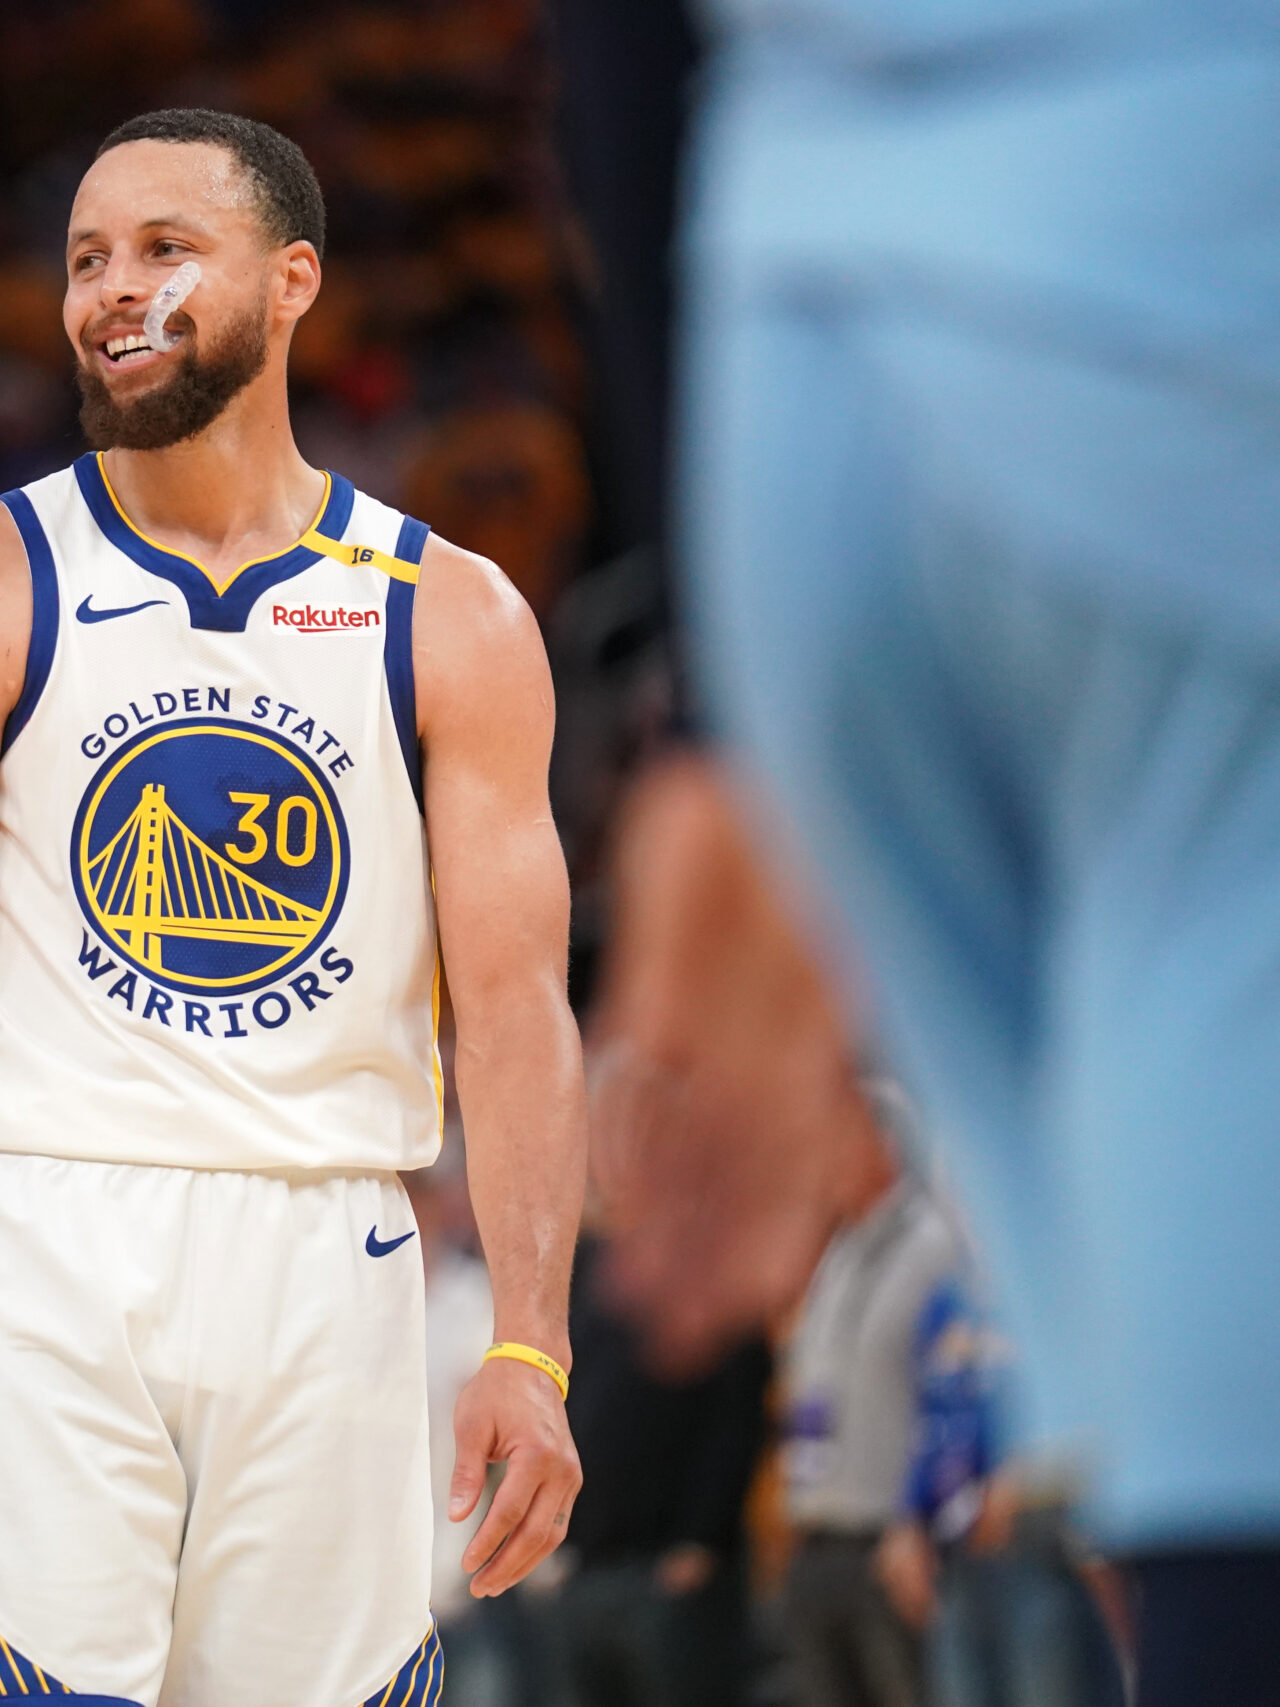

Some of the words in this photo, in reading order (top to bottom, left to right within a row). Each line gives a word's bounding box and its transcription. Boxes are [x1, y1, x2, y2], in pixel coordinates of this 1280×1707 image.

[351, 547, 375, 565] 16
[272, 604, 381, 628] Rakuten
[80, 686, 231, 760] GOLDEN
[251, 695, 355, 779] STATE
[224, 790, 318, 867] 30
[77, 927, 355, 1039] WARRIORS
